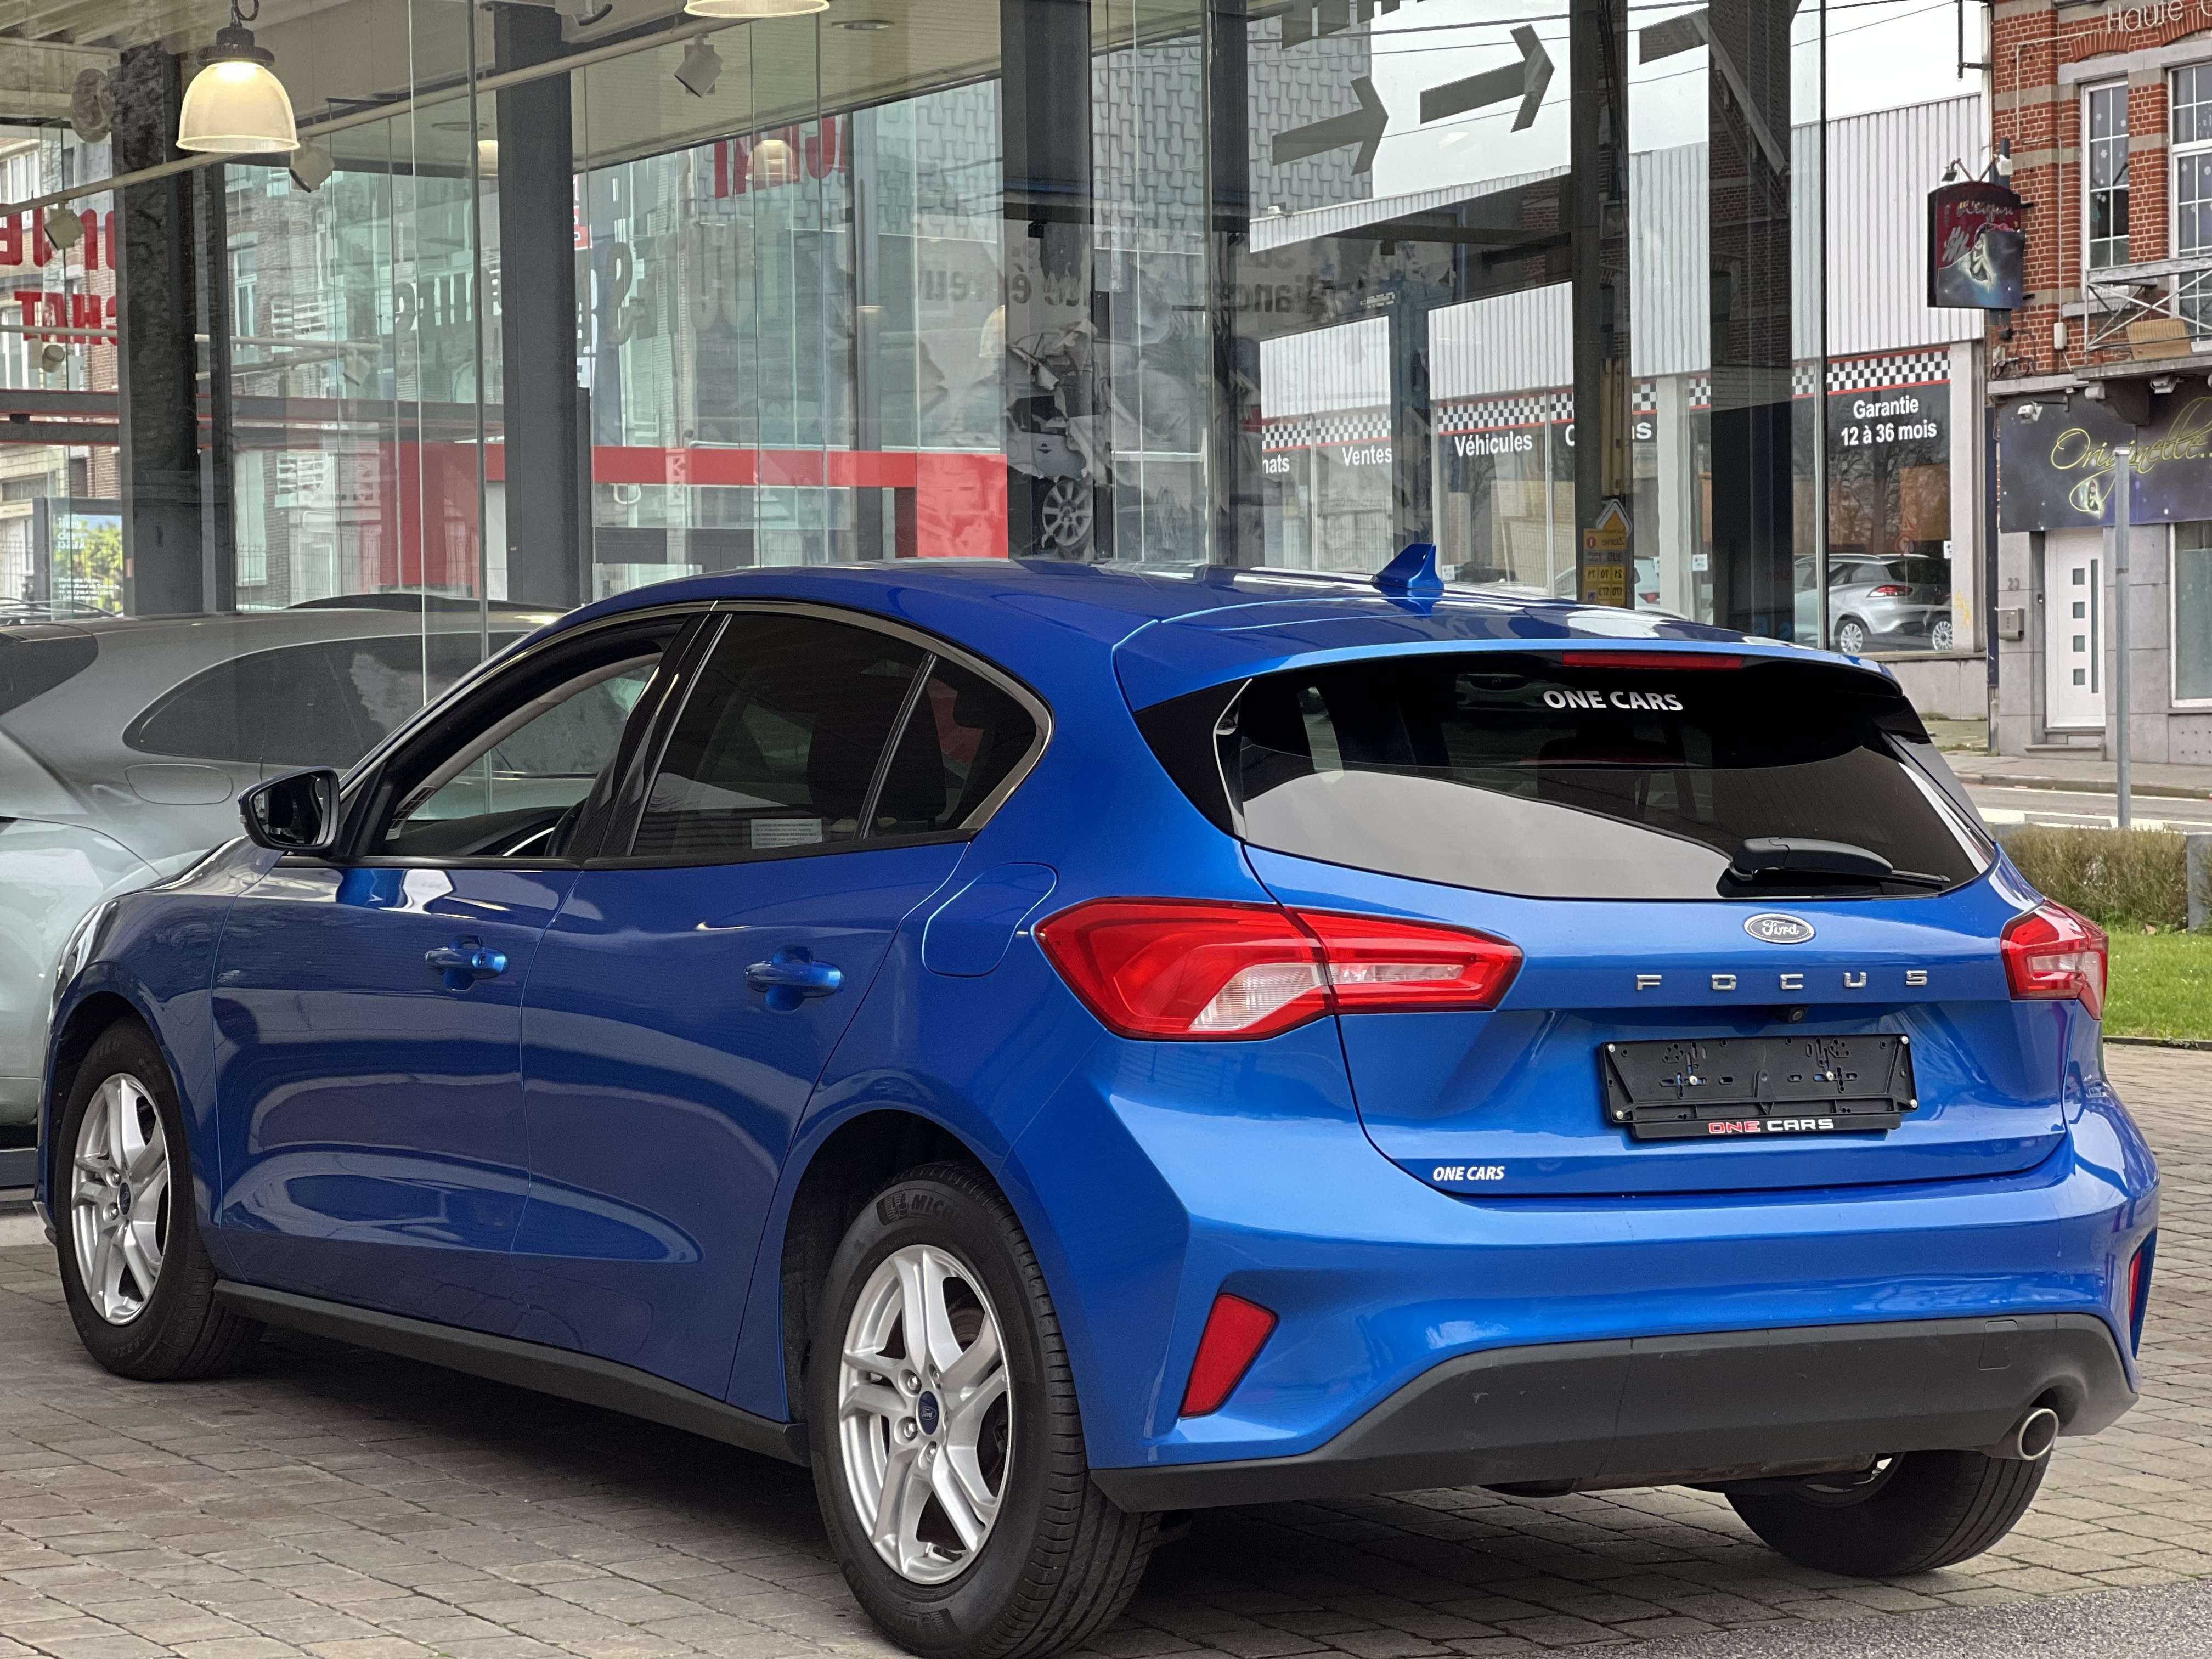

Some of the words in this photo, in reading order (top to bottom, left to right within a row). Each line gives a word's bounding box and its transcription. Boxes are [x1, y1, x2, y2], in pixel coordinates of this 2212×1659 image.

[2108, 0, 2183, 34] Haute
[1853, 395, 1920, 419] Garantie
[1841, 427, 1859, 447] 12
[1863, 425, 1872, 444] à
[1876, 422, 1895, 443] 36
[1898, 419, 1937, 441] mois
[1342, 445, 1392, 466] Ventes
[1454, 430, 1533, 457] Véhicules
[1543, 690, 1607, 708] ONE
[1610, 691, 1683, 711] CARS
[1762, 919, 1799, 935] Ford
[1635, 970, 1928, 991] FOCUS
[1708, 1121, 1761, 1134] ONE
[1767, 1119, 1834, 1131] CARS
[1432, 1166, 1465, 1181] ONE
[1466, 1166, 1505, 1181] CARS
